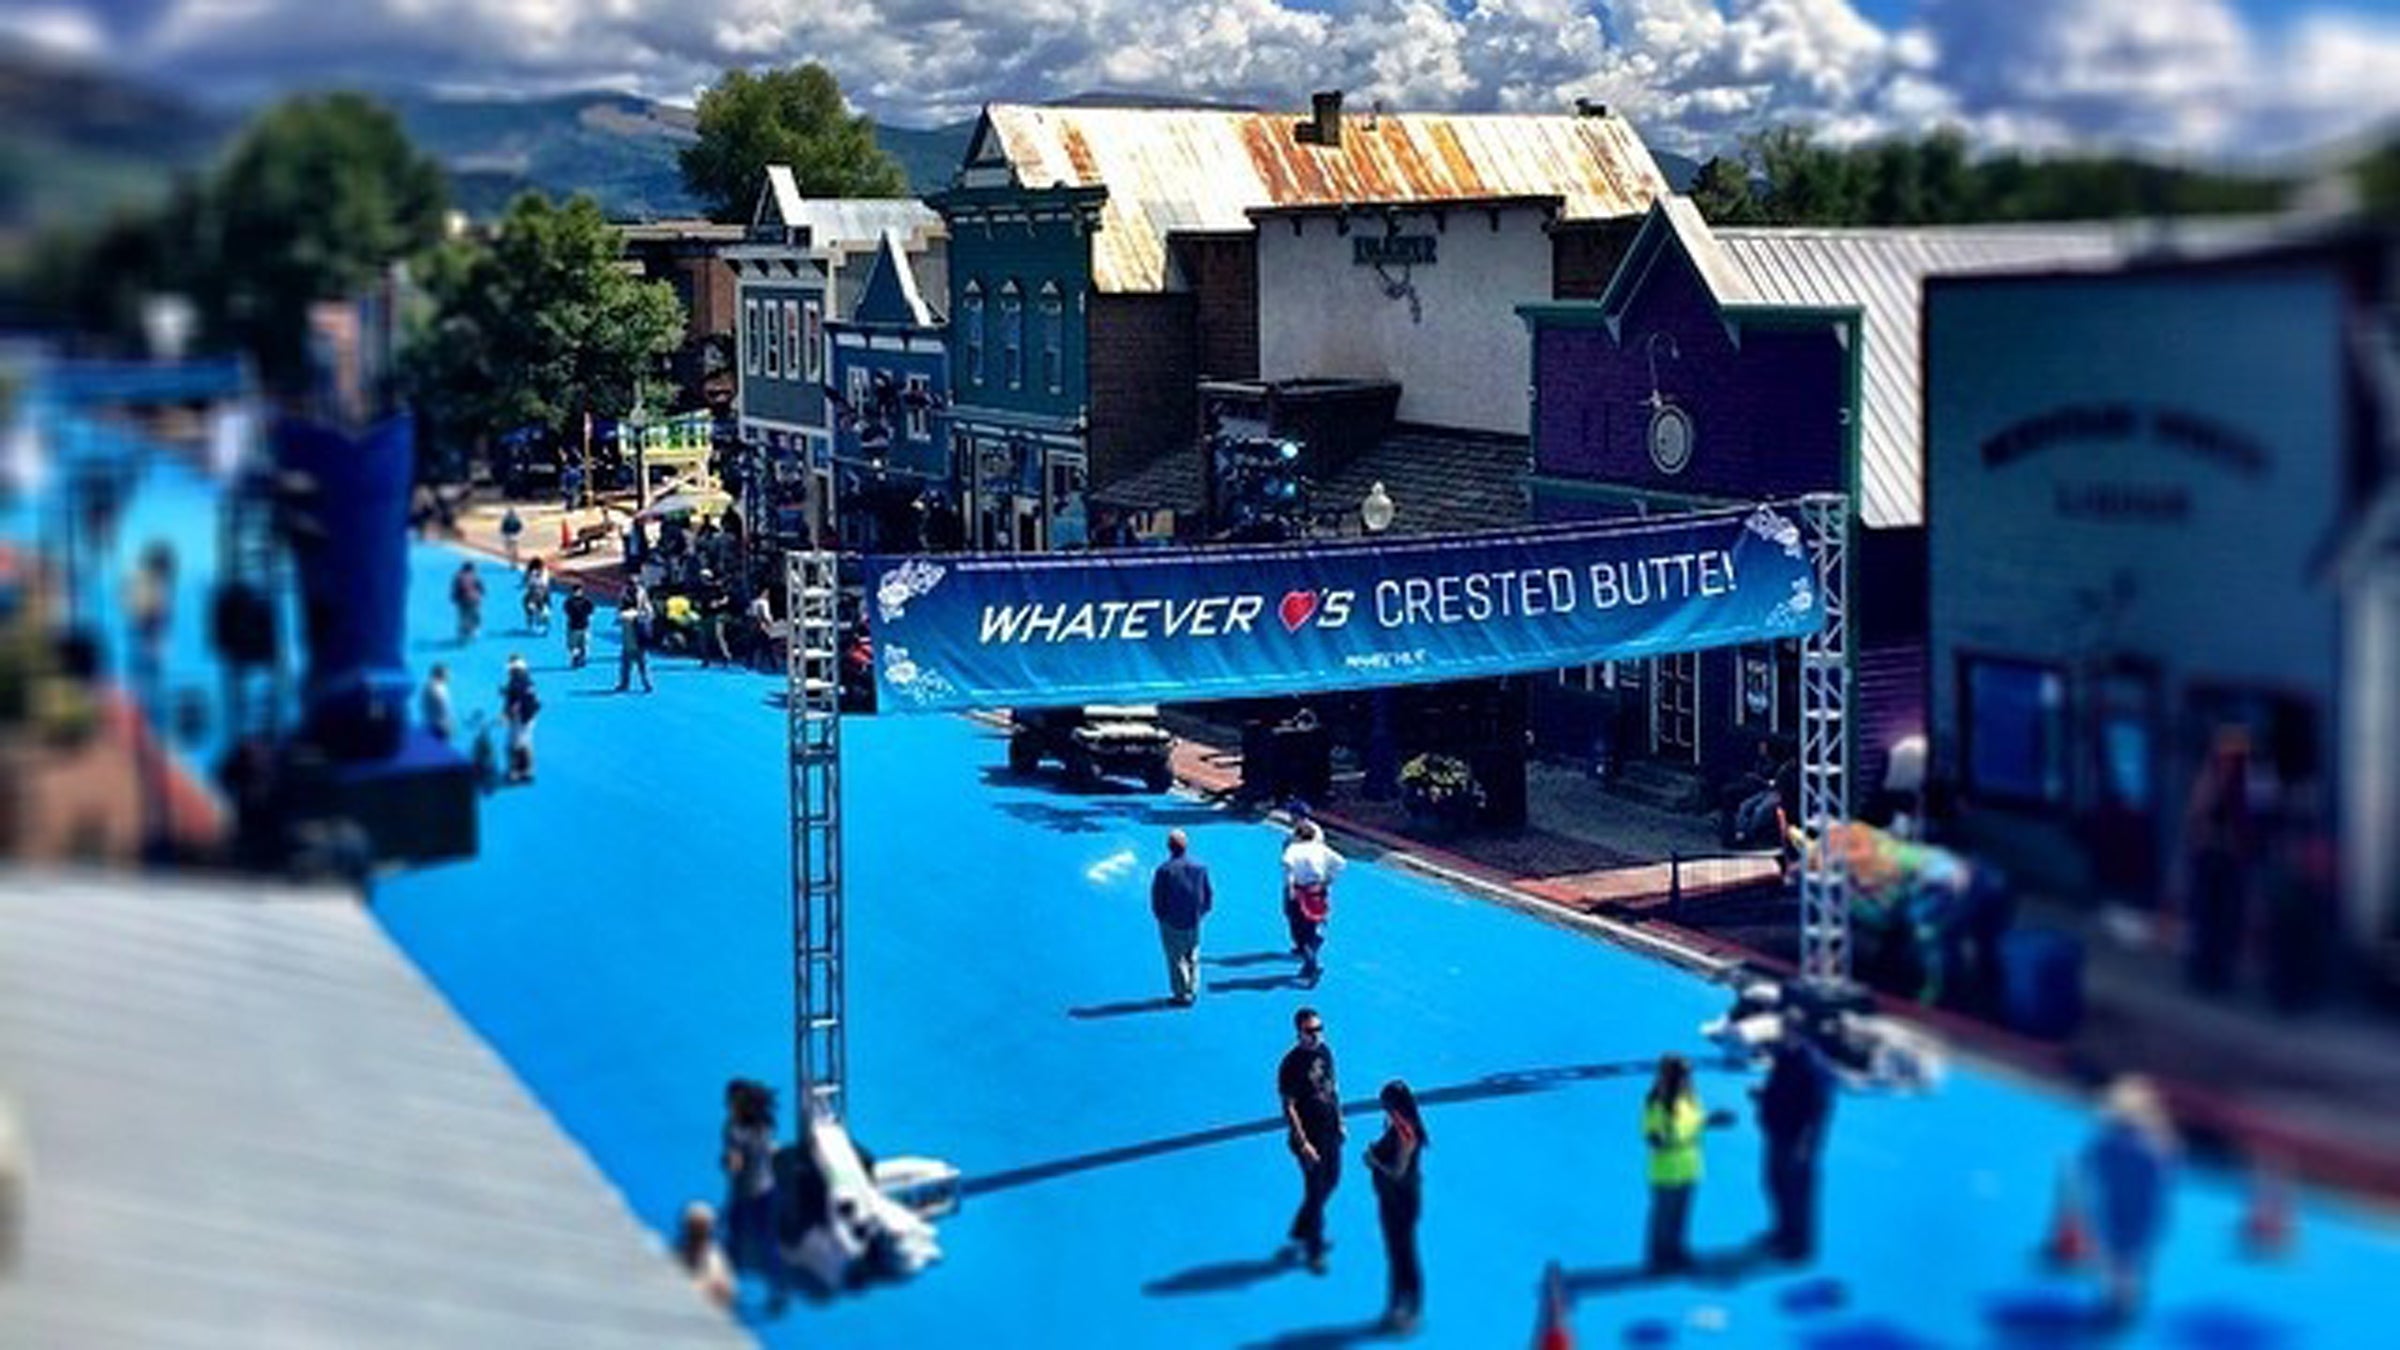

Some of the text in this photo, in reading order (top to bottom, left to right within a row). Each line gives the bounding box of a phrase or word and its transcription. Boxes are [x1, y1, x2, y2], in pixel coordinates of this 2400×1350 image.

[978, 595, 1263, 643] WHATEVER
[1375, 567, 1577, 628] CRESTED
[1589, 550, 1738, 609] BUTTE!
